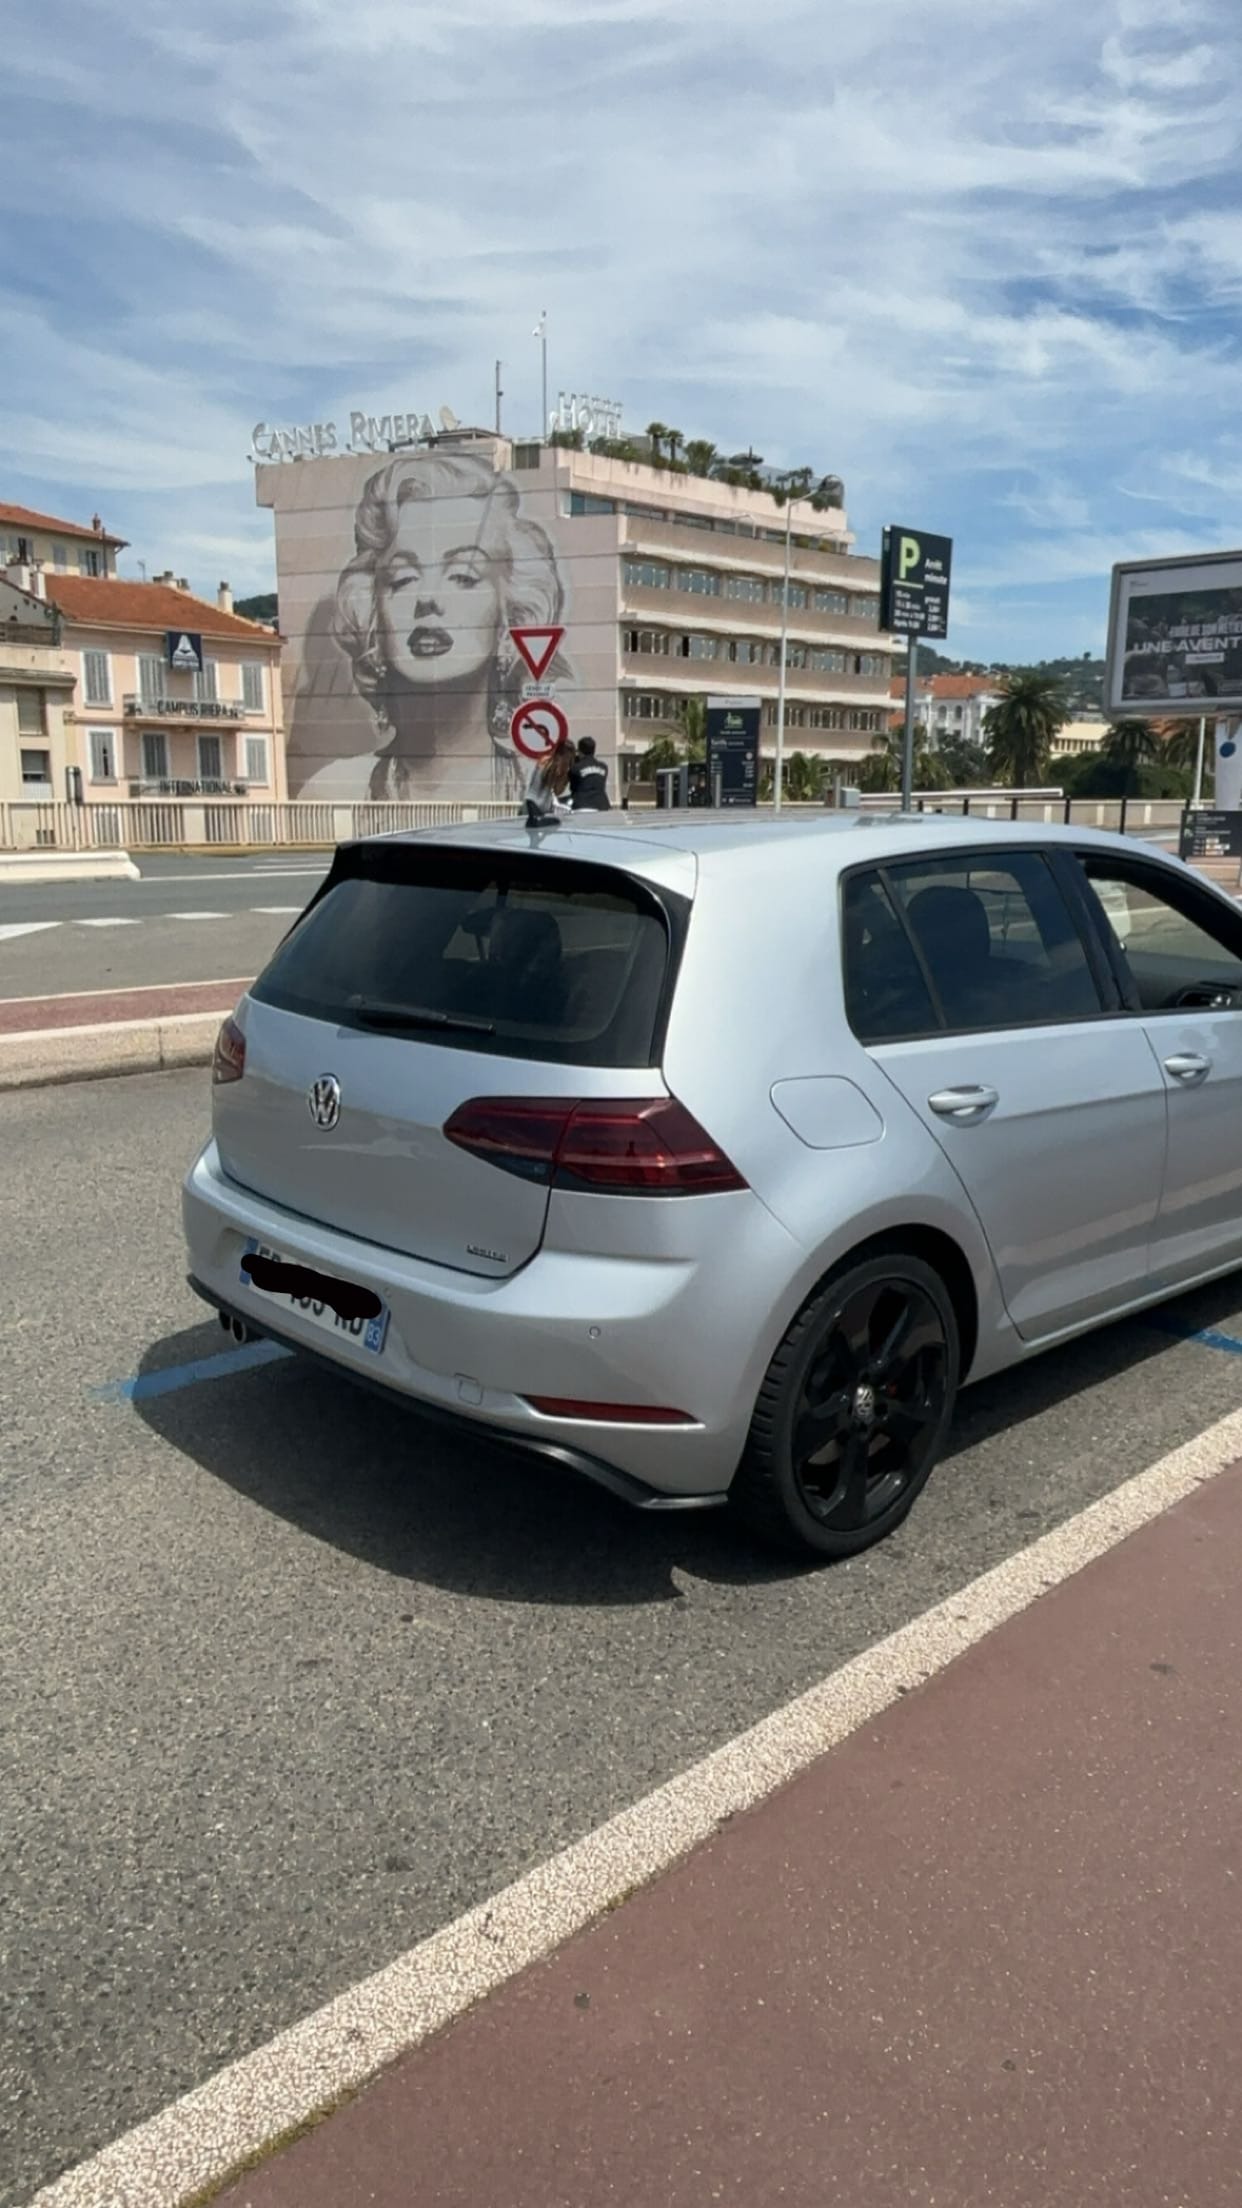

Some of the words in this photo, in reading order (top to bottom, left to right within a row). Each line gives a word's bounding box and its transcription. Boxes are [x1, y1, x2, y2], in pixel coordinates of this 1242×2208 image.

[251, 422, 338, 457] CANNES
[350, 411, 438, 446] RIVIERA
[899, 536, 920, 579] P
[1133, 640, 1173, 655] UNE
[157, 700, 199, 716] CAMPUS
[160, 780, 233, 795] INTERNATIONAL
